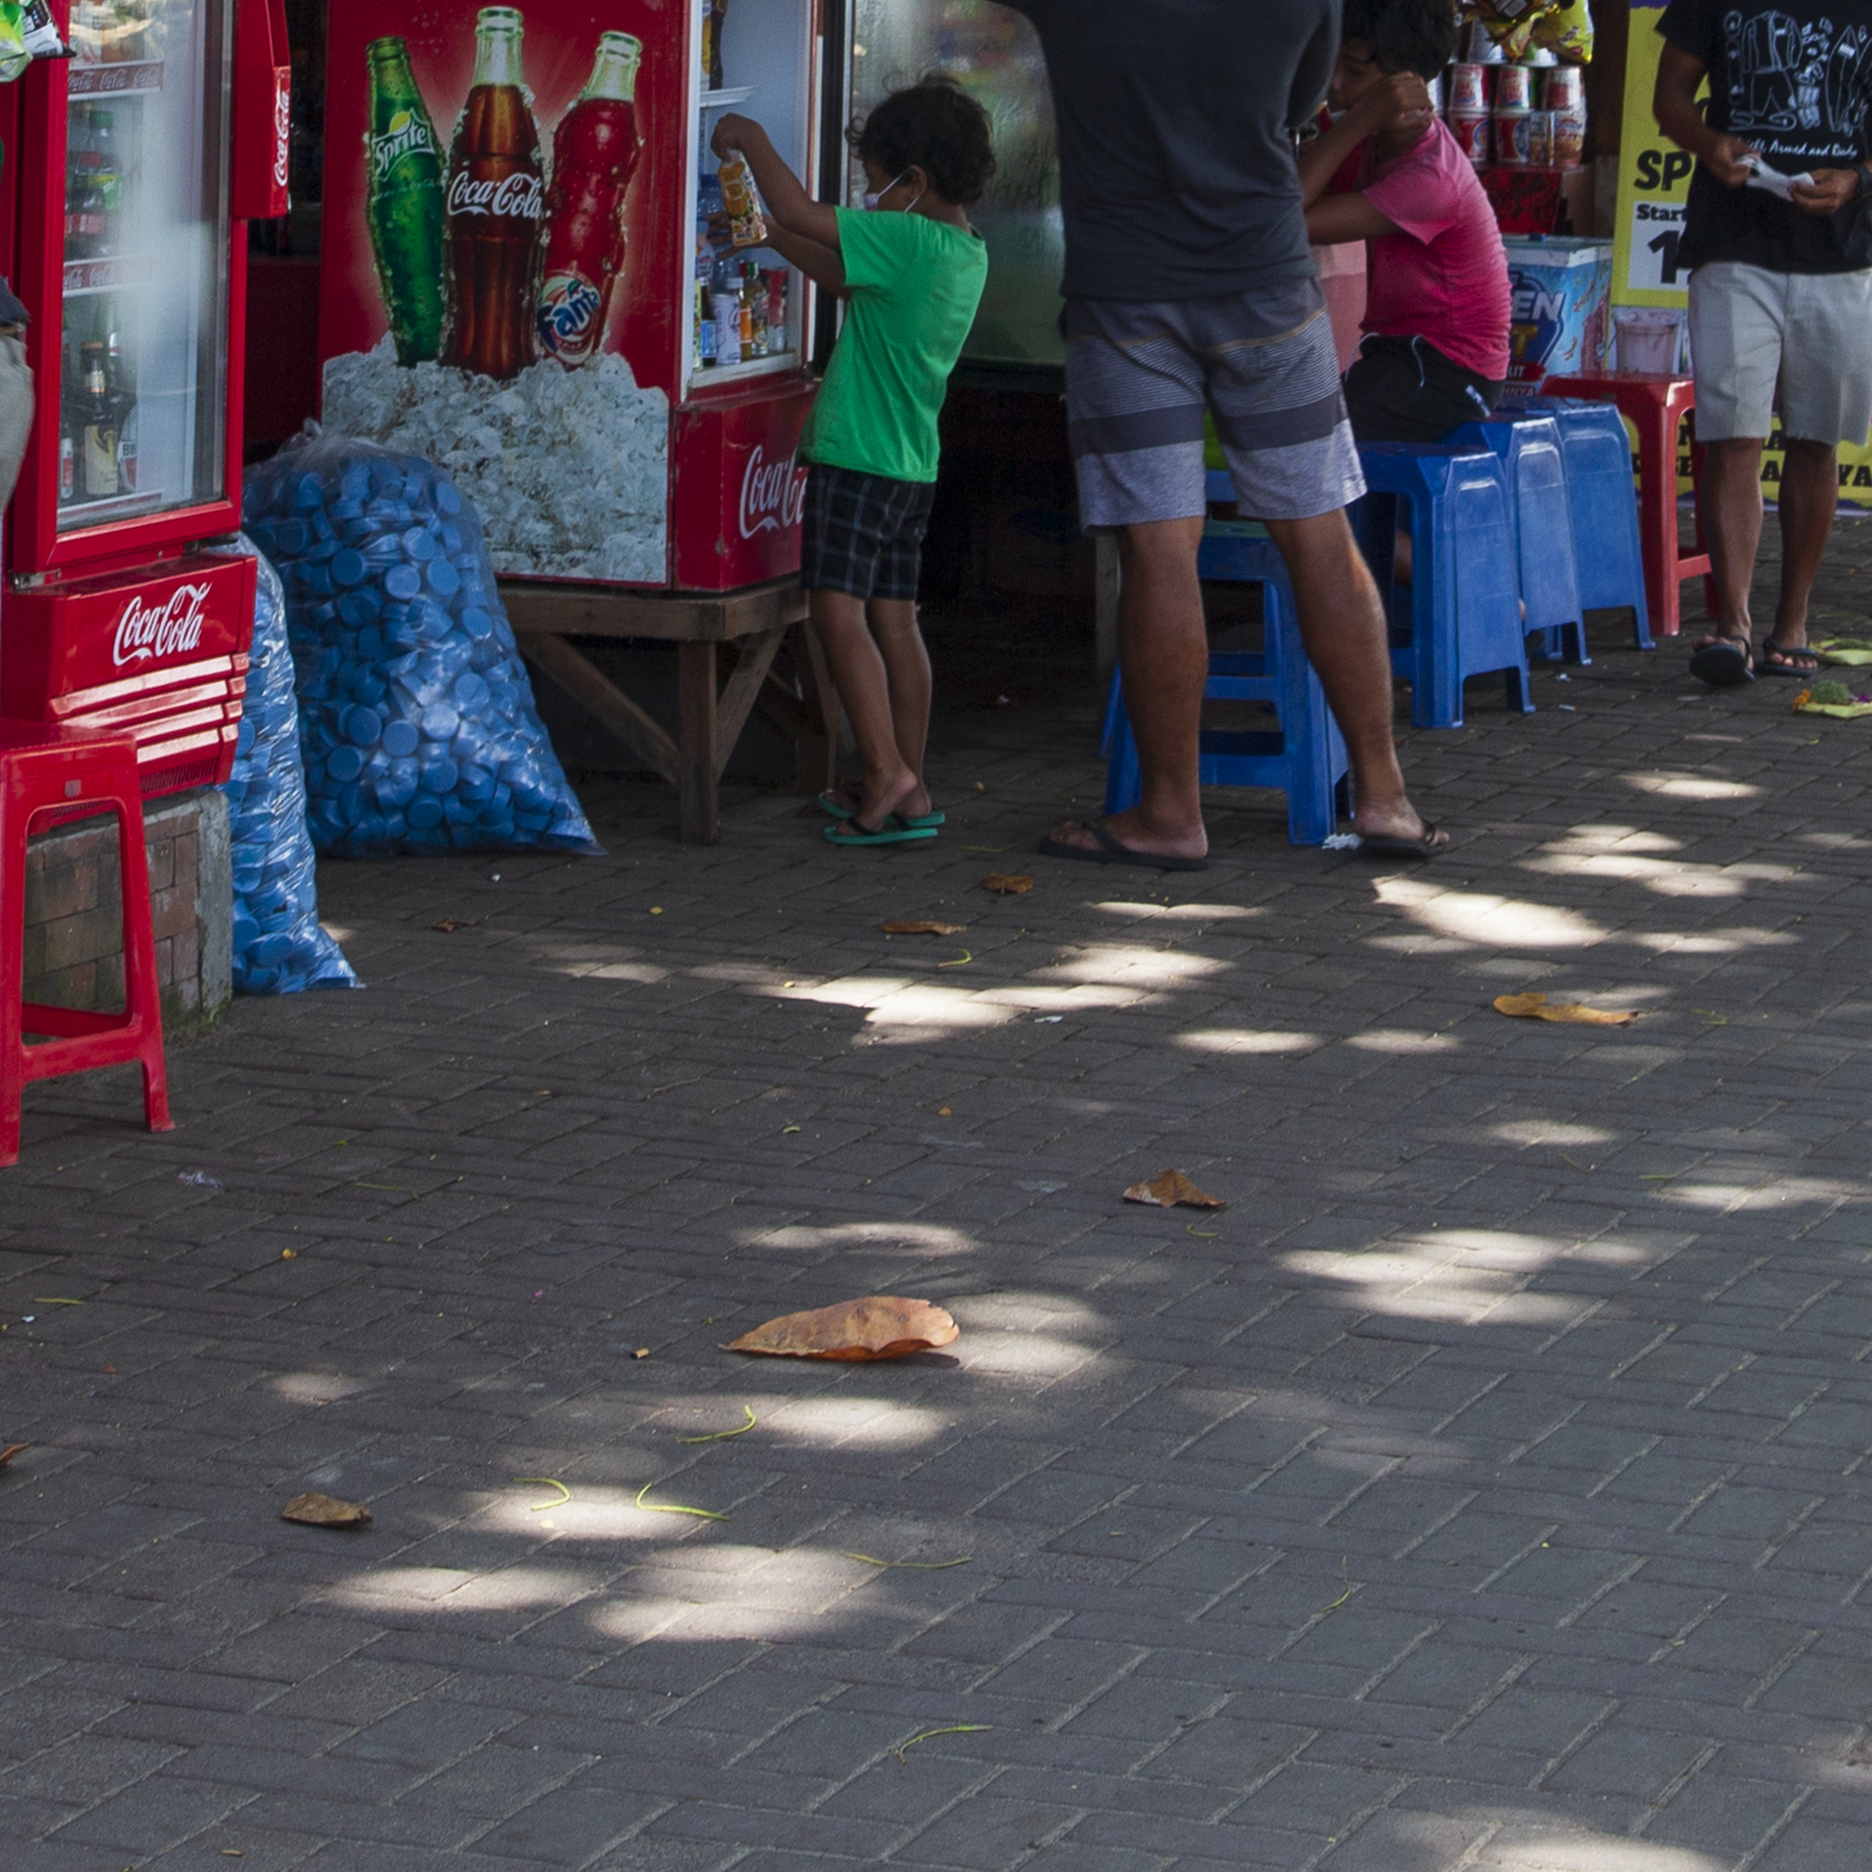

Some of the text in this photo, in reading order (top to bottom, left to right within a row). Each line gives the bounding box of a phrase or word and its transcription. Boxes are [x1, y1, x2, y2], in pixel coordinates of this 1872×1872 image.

[372, 123, 431, 179] Sprite
[447, 170, 544, 220] Coca-Cola
[538, 280, 602, 338] Fanta
[113, 581, 213, 666] Coca-Cola
